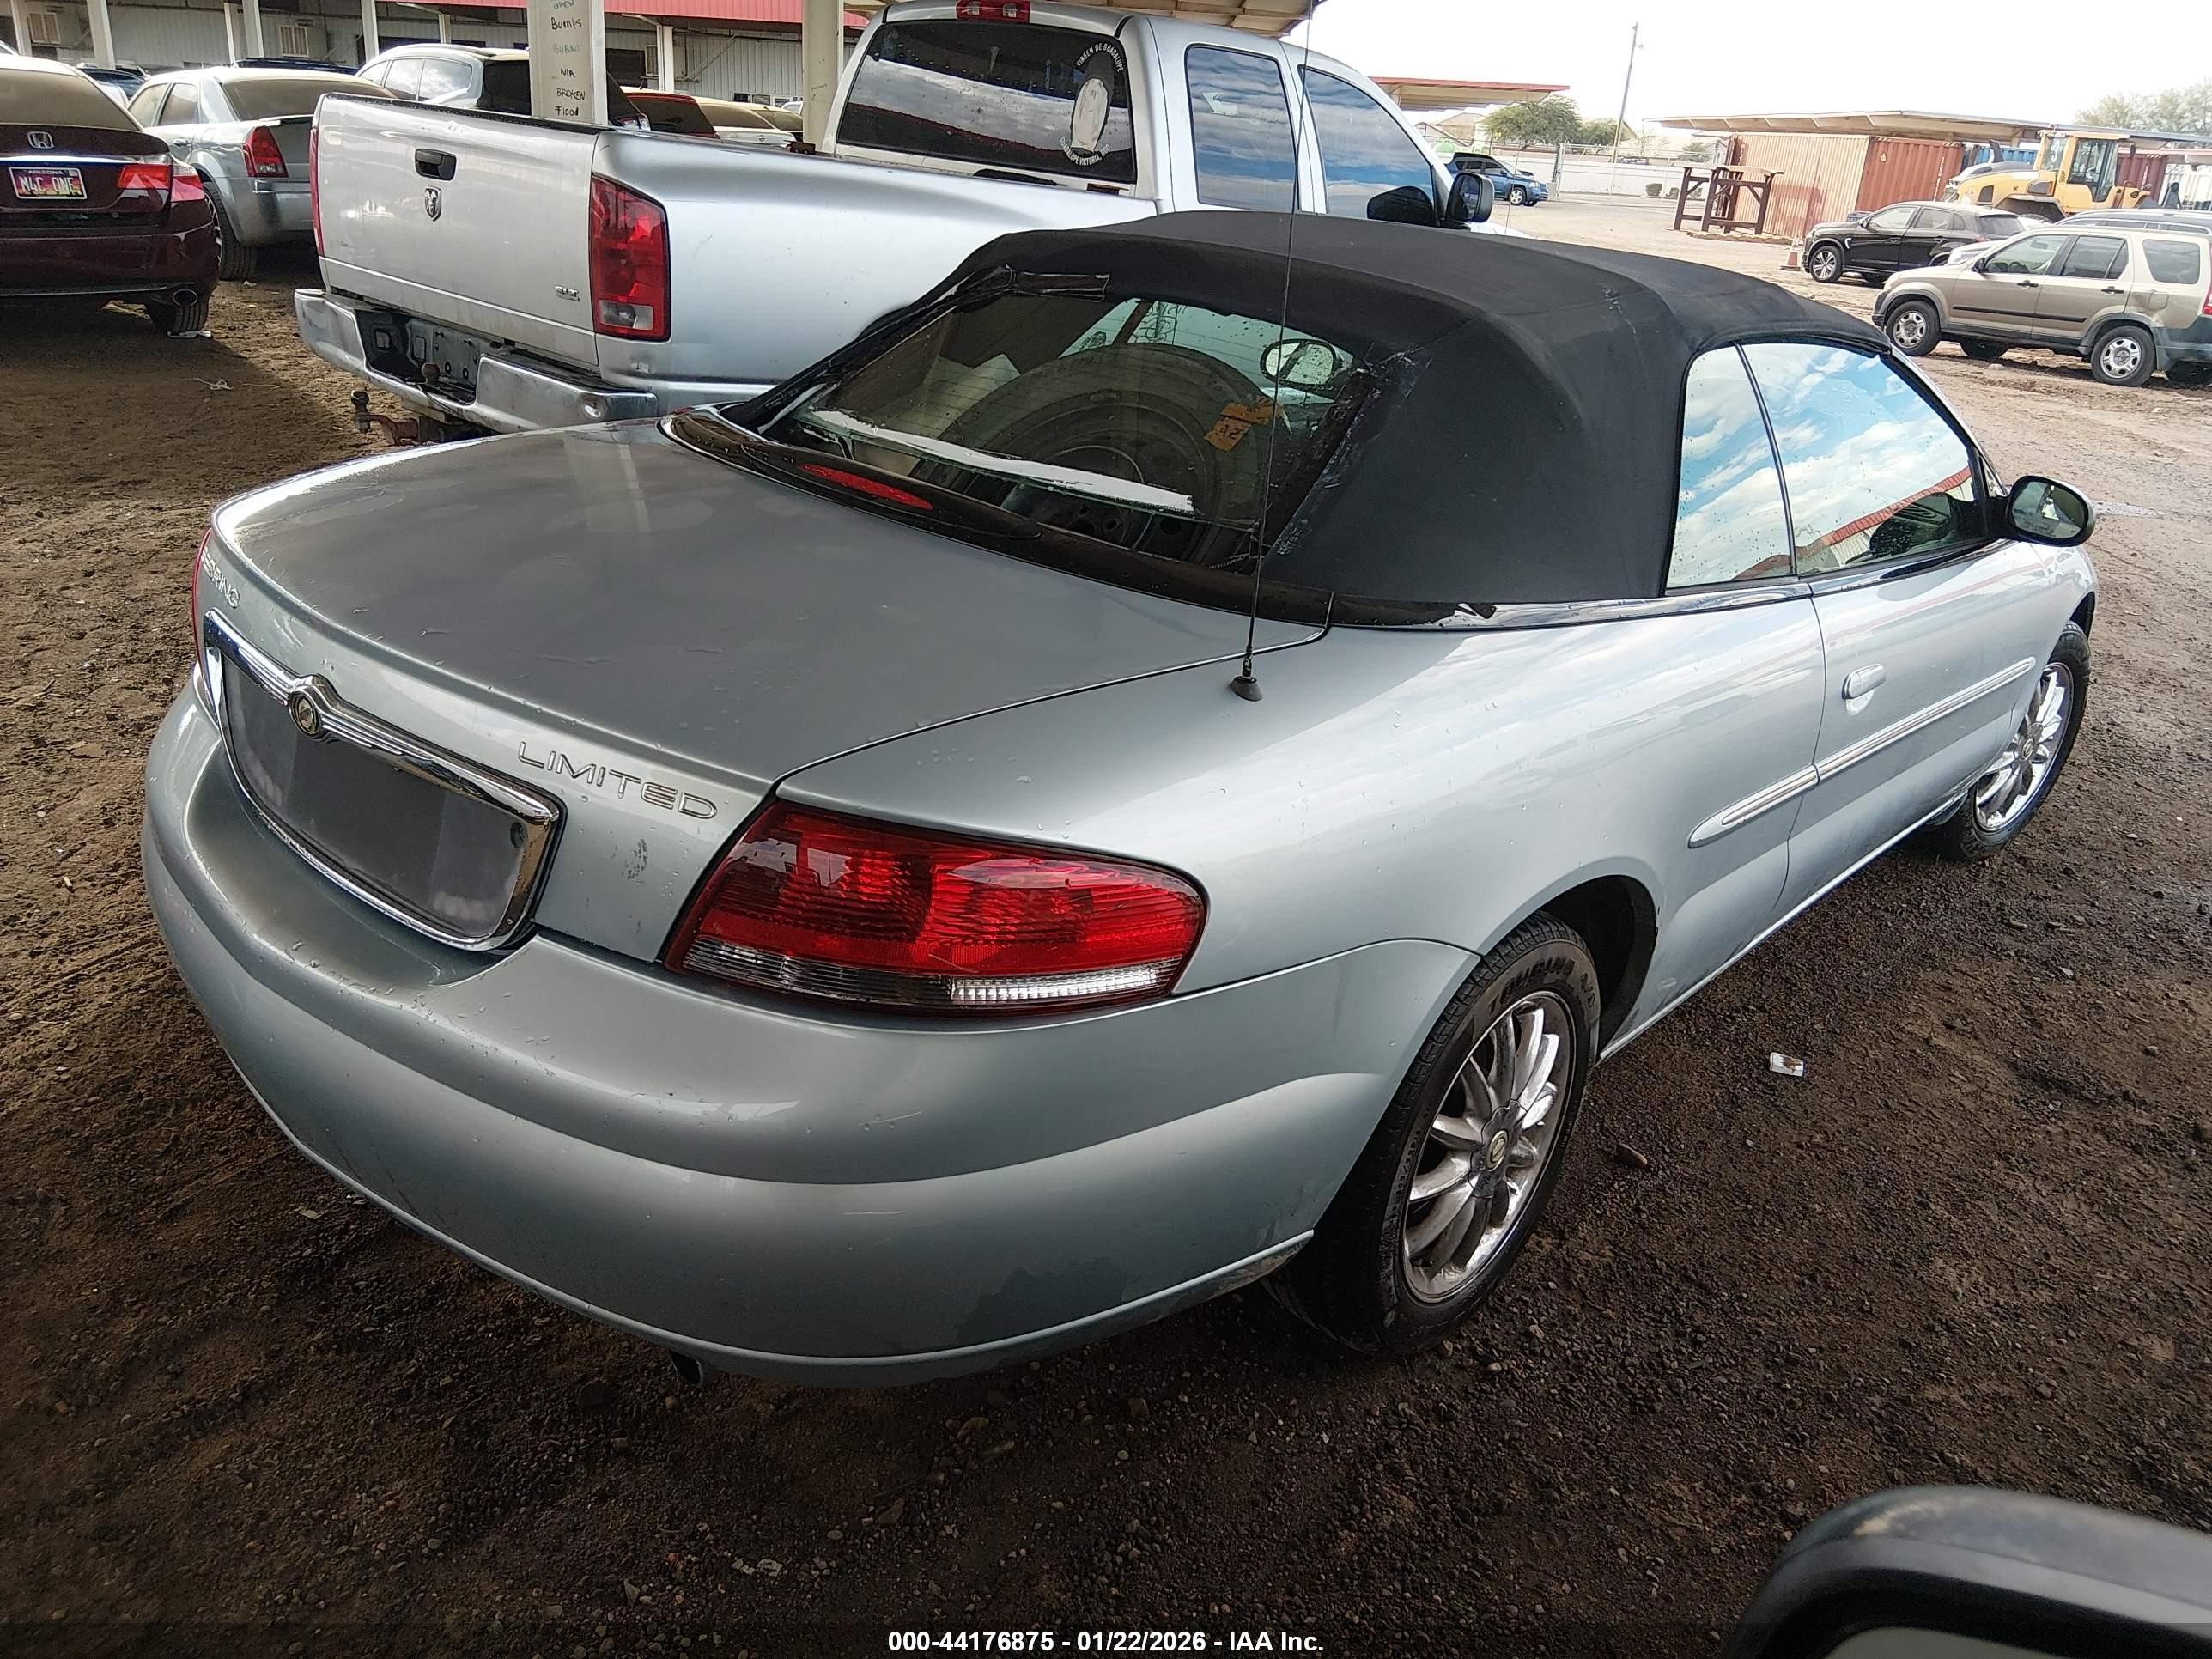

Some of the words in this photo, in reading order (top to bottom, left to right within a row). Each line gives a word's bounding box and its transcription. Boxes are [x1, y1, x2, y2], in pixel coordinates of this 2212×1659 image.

[1075, 46, 1094, 66] VIRGEN
[1095, 42, 1103, 52] DE
[1103, 42, 1124, 73] GUADALUPE
[556, 88, 586, 101] BROKEN
[52, 176, 75, 194] ONE
[517, 741, 718, 820] LIMITED
